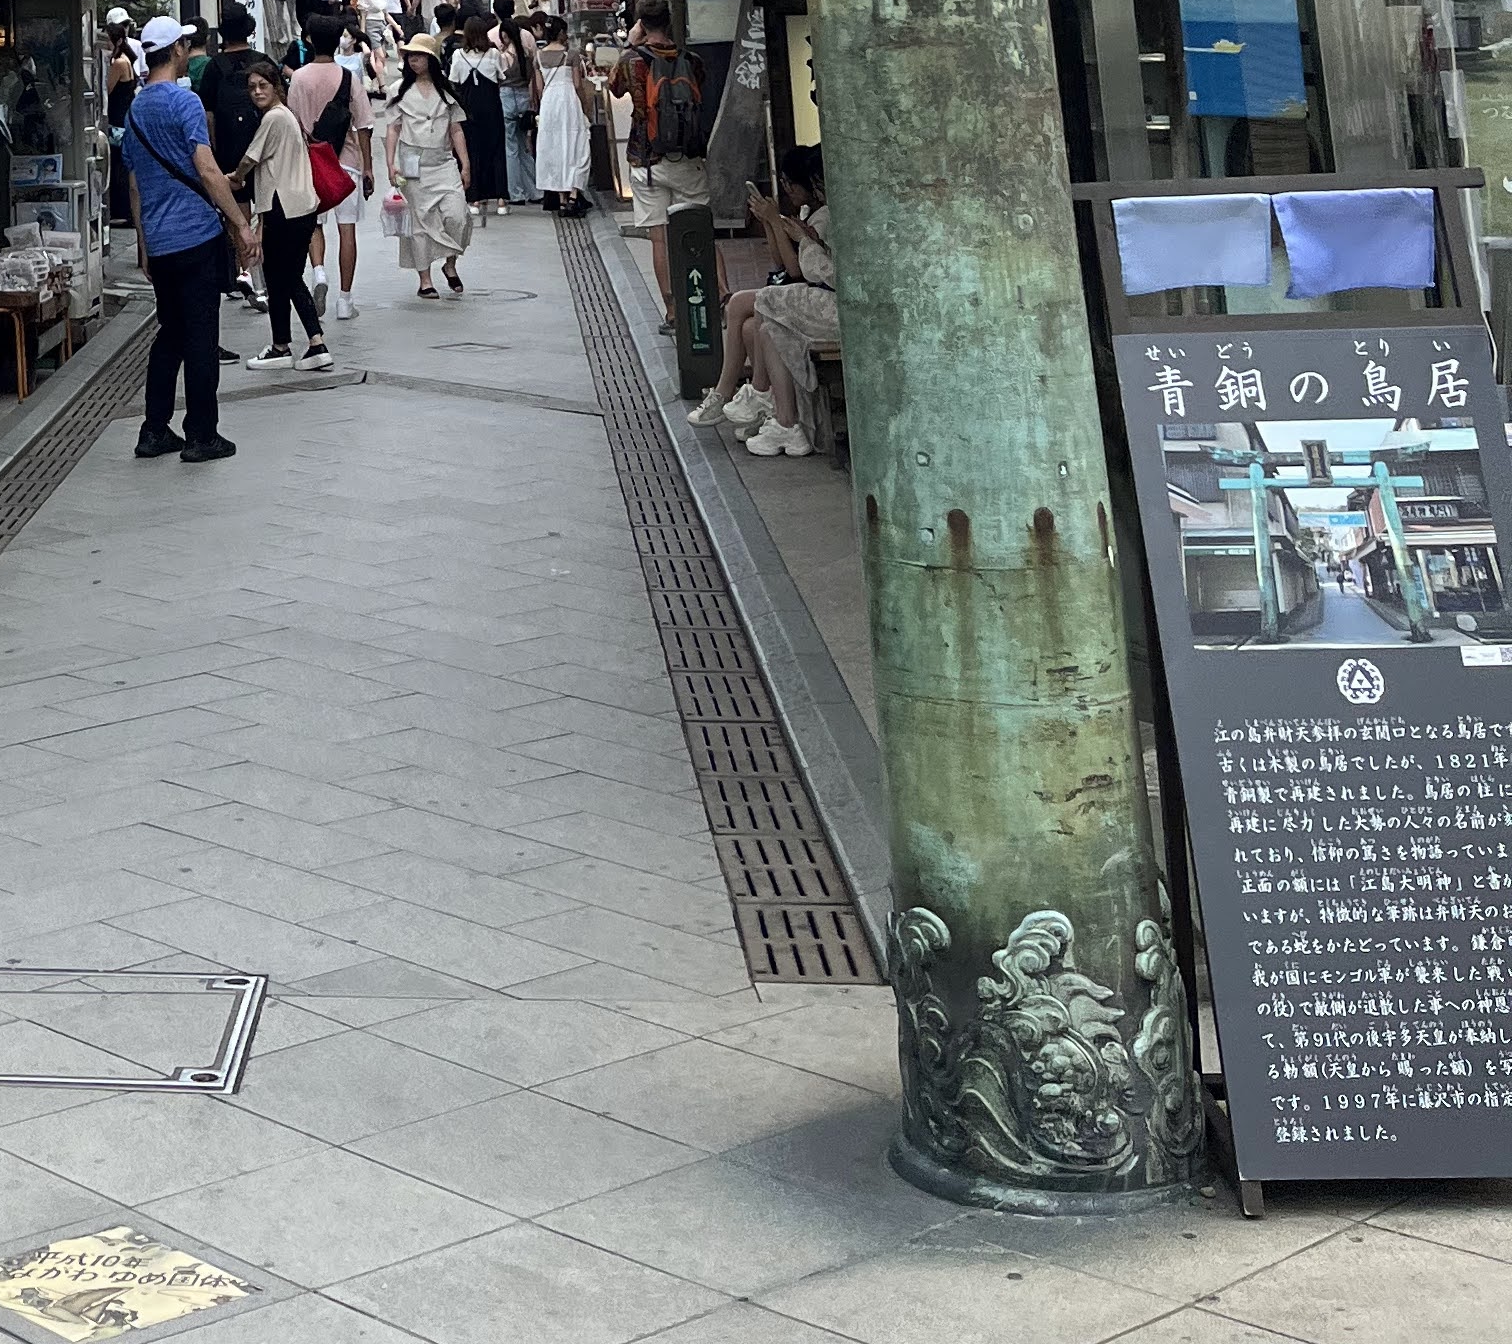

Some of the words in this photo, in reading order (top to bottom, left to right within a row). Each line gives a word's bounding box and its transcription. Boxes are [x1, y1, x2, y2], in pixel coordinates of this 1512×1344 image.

[1145, 344, 1187, 362] せい
[1216, 341, 1254, 361] どう
[1352, 337, 1392, 357] とり
[1432, 339, 1452, 353] い
[1146, 358, 1470, 418] 青銅の鳥居
[1248, 932, 1512, 956] である蛇をかたどっています。鎌倉
[1275, 1124, 1398, 1144] 登録されました。
[35, 1250, 152, 1269] 平成10年
